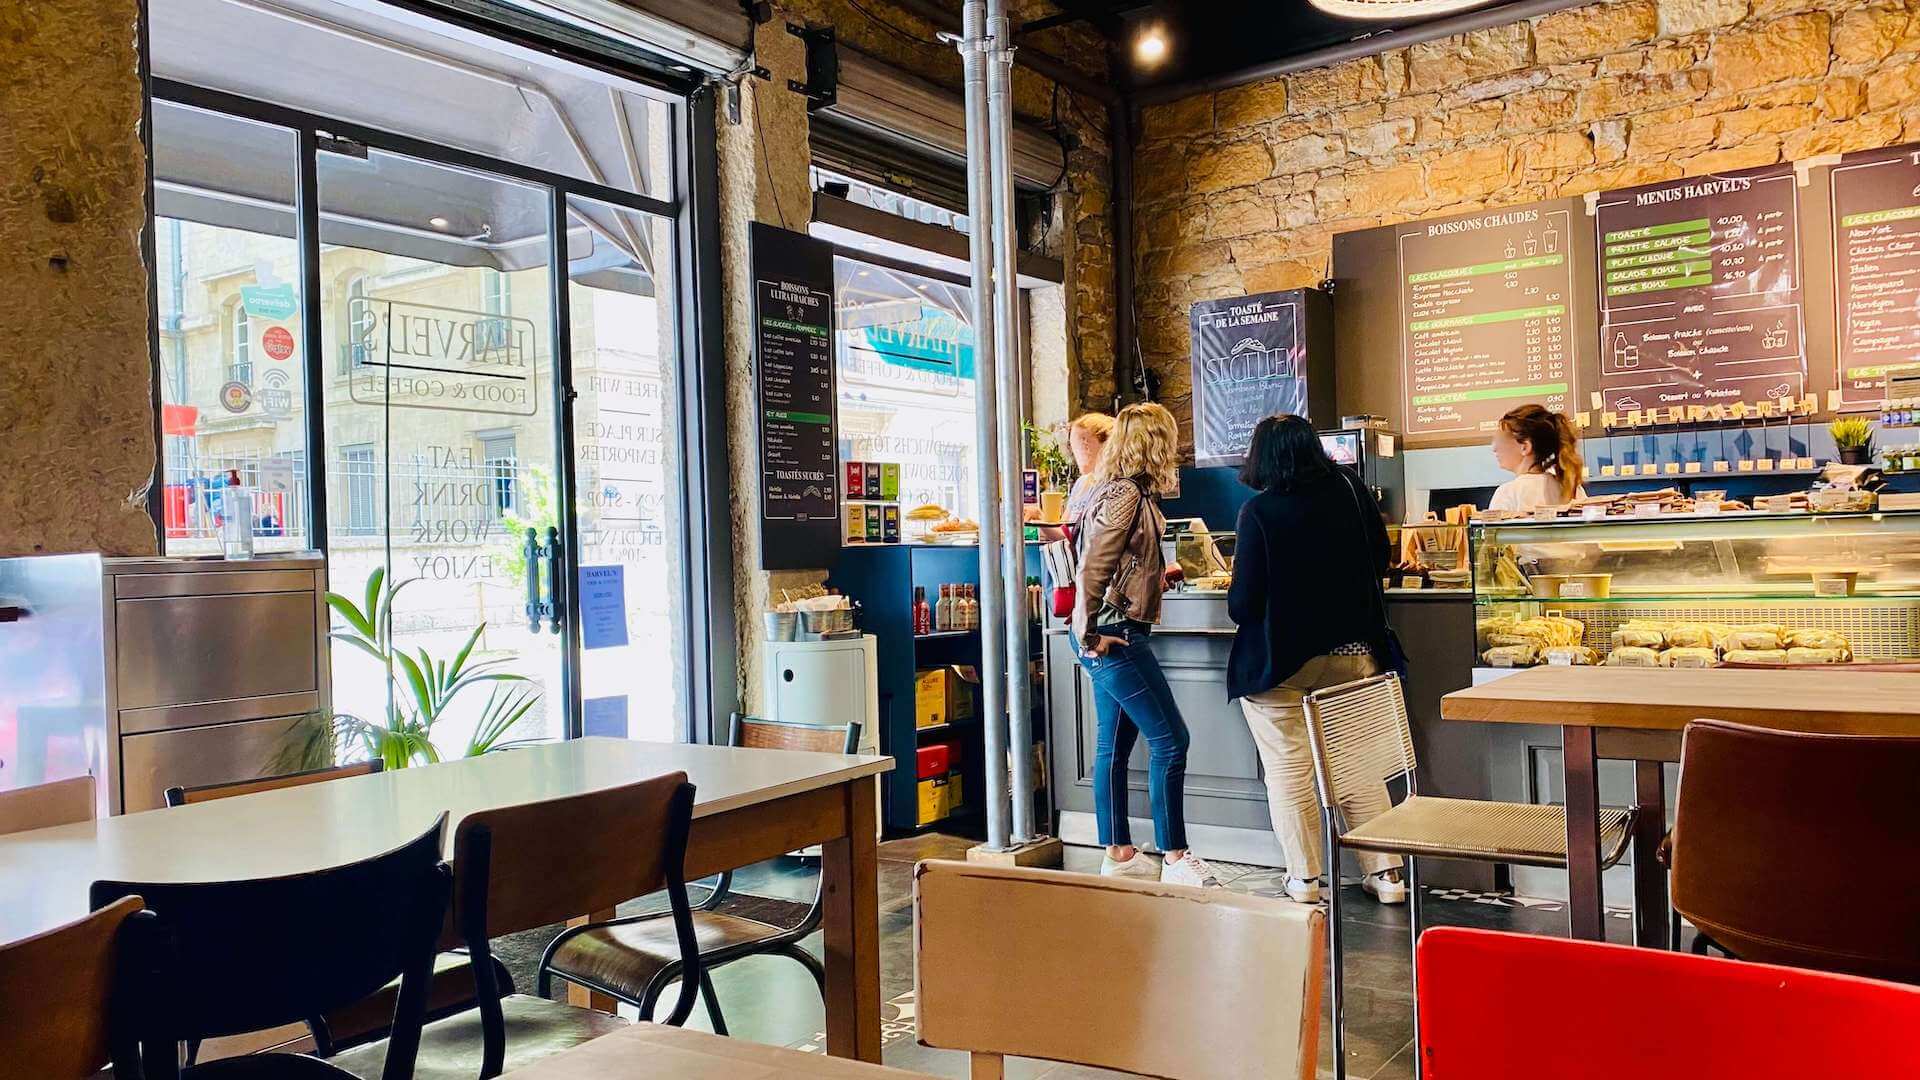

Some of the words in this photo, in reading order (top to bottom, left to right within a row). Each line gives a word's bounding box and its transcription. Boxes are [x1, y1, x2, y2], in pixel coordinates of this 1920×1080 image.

[1636, 186, 1682, 207] MENUS
[1684, 178, 1751, 199] HARVEL'S
[1428, 217, 1482, 237] BOISSONS
[1483, 209, 1539, 228] CHAUDES
[1654, 236, 1691, 248] SALADE
[1612, 257, 1635, 268] PLAT
[1612, 267, 1649, 280] SALADE
[780, 281, 810, 295] BOISSONS
[770, 289, 790, 302] ULTRA
[1229, 301, 1263, 316] TOASTÉ
[1683, 304, 1705, 314] AVEC
[1215, 318, 1228, 329] DE
[1228, 316, 1241, 328] LA
[1240, 311, 1279, 327] SEMAINE
[1641, 331, 1672, 342] Boisson
[1413, 340, 1441, 349] Chocolat
[1414, 349, 1441, 358] Chocolat
[1667, 347, 1697, 359] Boisson
[1699, 344, 1729, 355] chaude
[1658, 391, 1690, 402] Dessert
[776, 468, 802, 481] TOASTÉS
[802, 469, 825, 482] SUCRÉS
